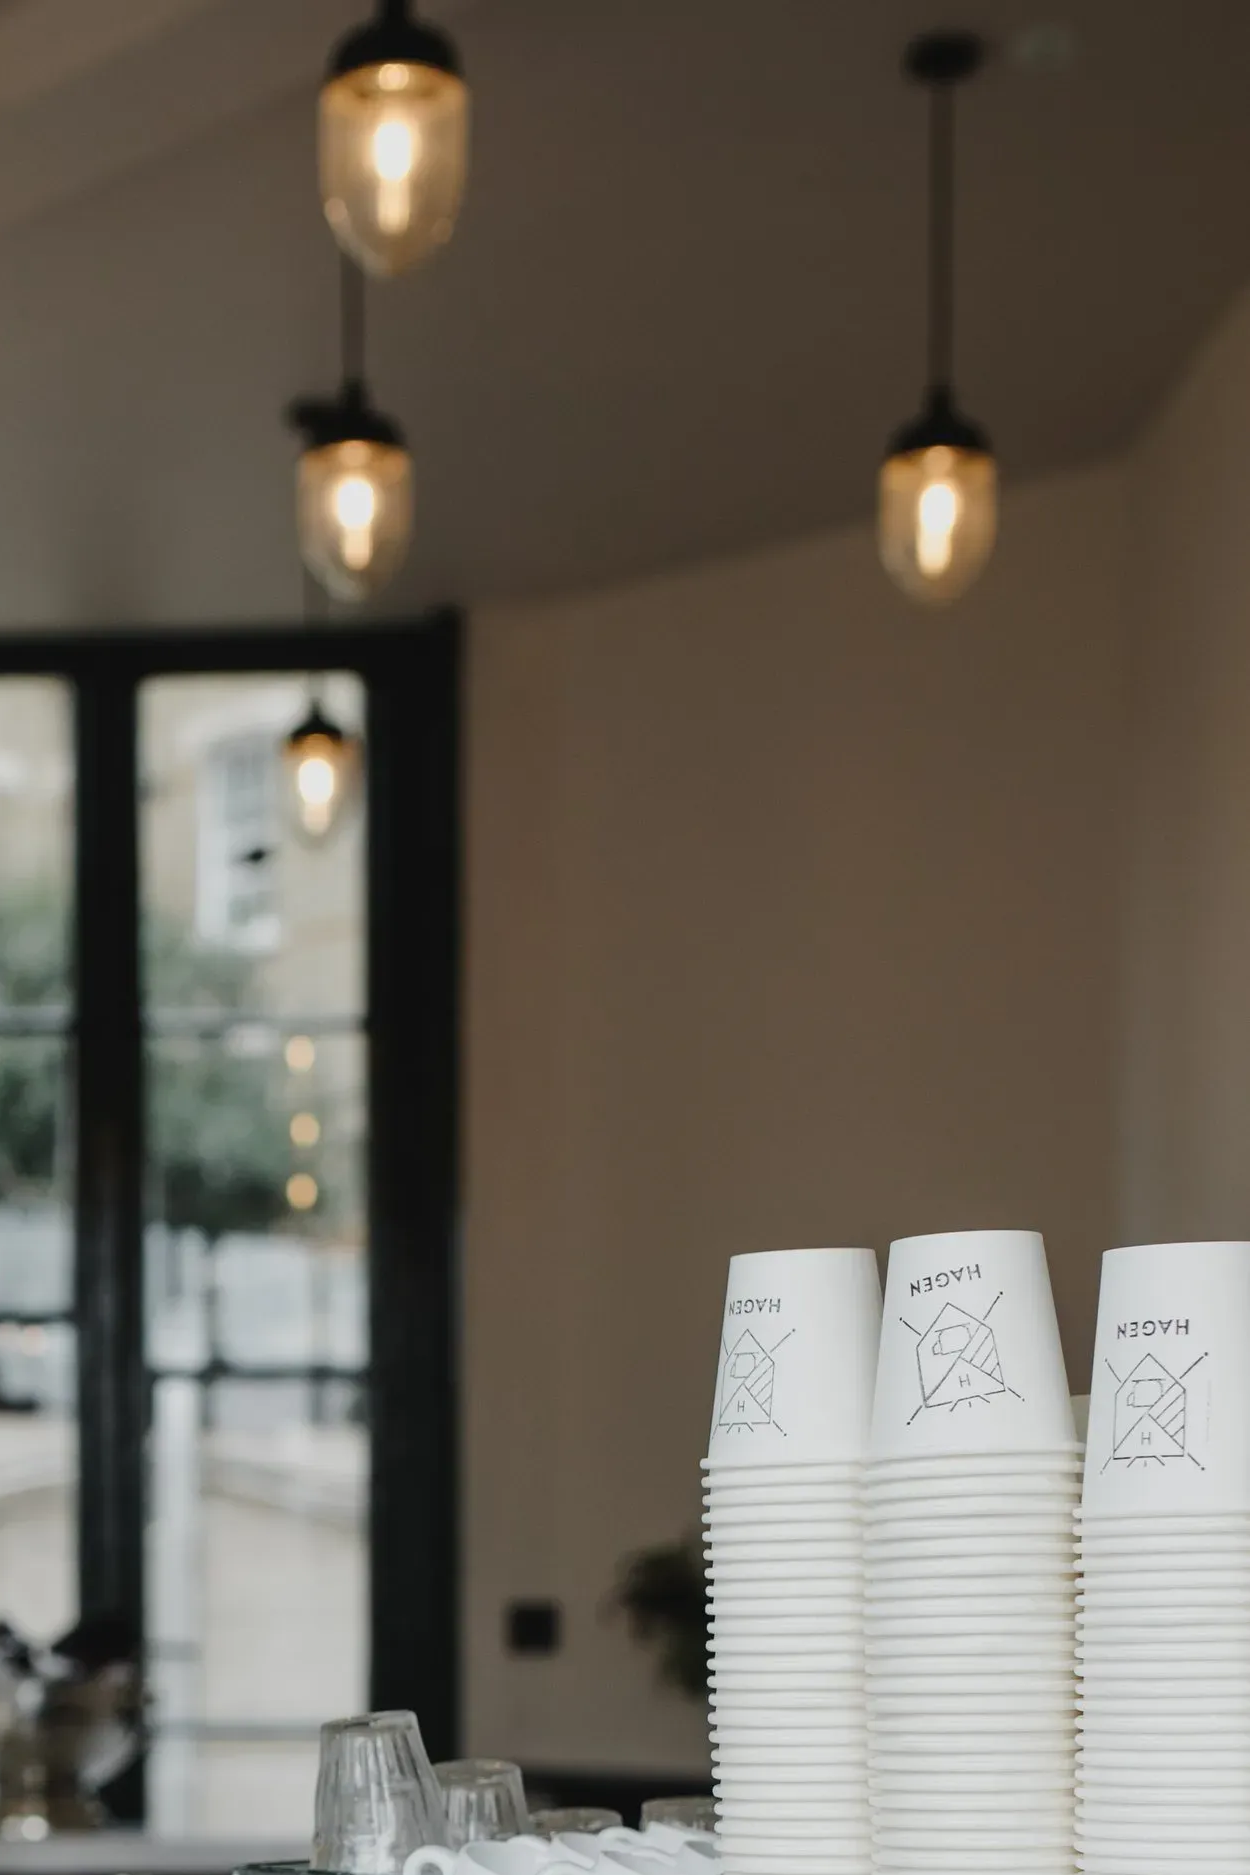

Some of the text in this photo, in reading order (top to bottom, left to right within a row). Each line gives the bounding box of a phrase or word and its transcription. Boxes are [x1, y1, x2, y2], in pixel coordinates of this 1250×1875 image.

[909, 1263, 982, 1297] HAGEN
[728, 1298, 781, 1316] HAGEN
[1116, 1318, 1190, 1340] HAGEN
